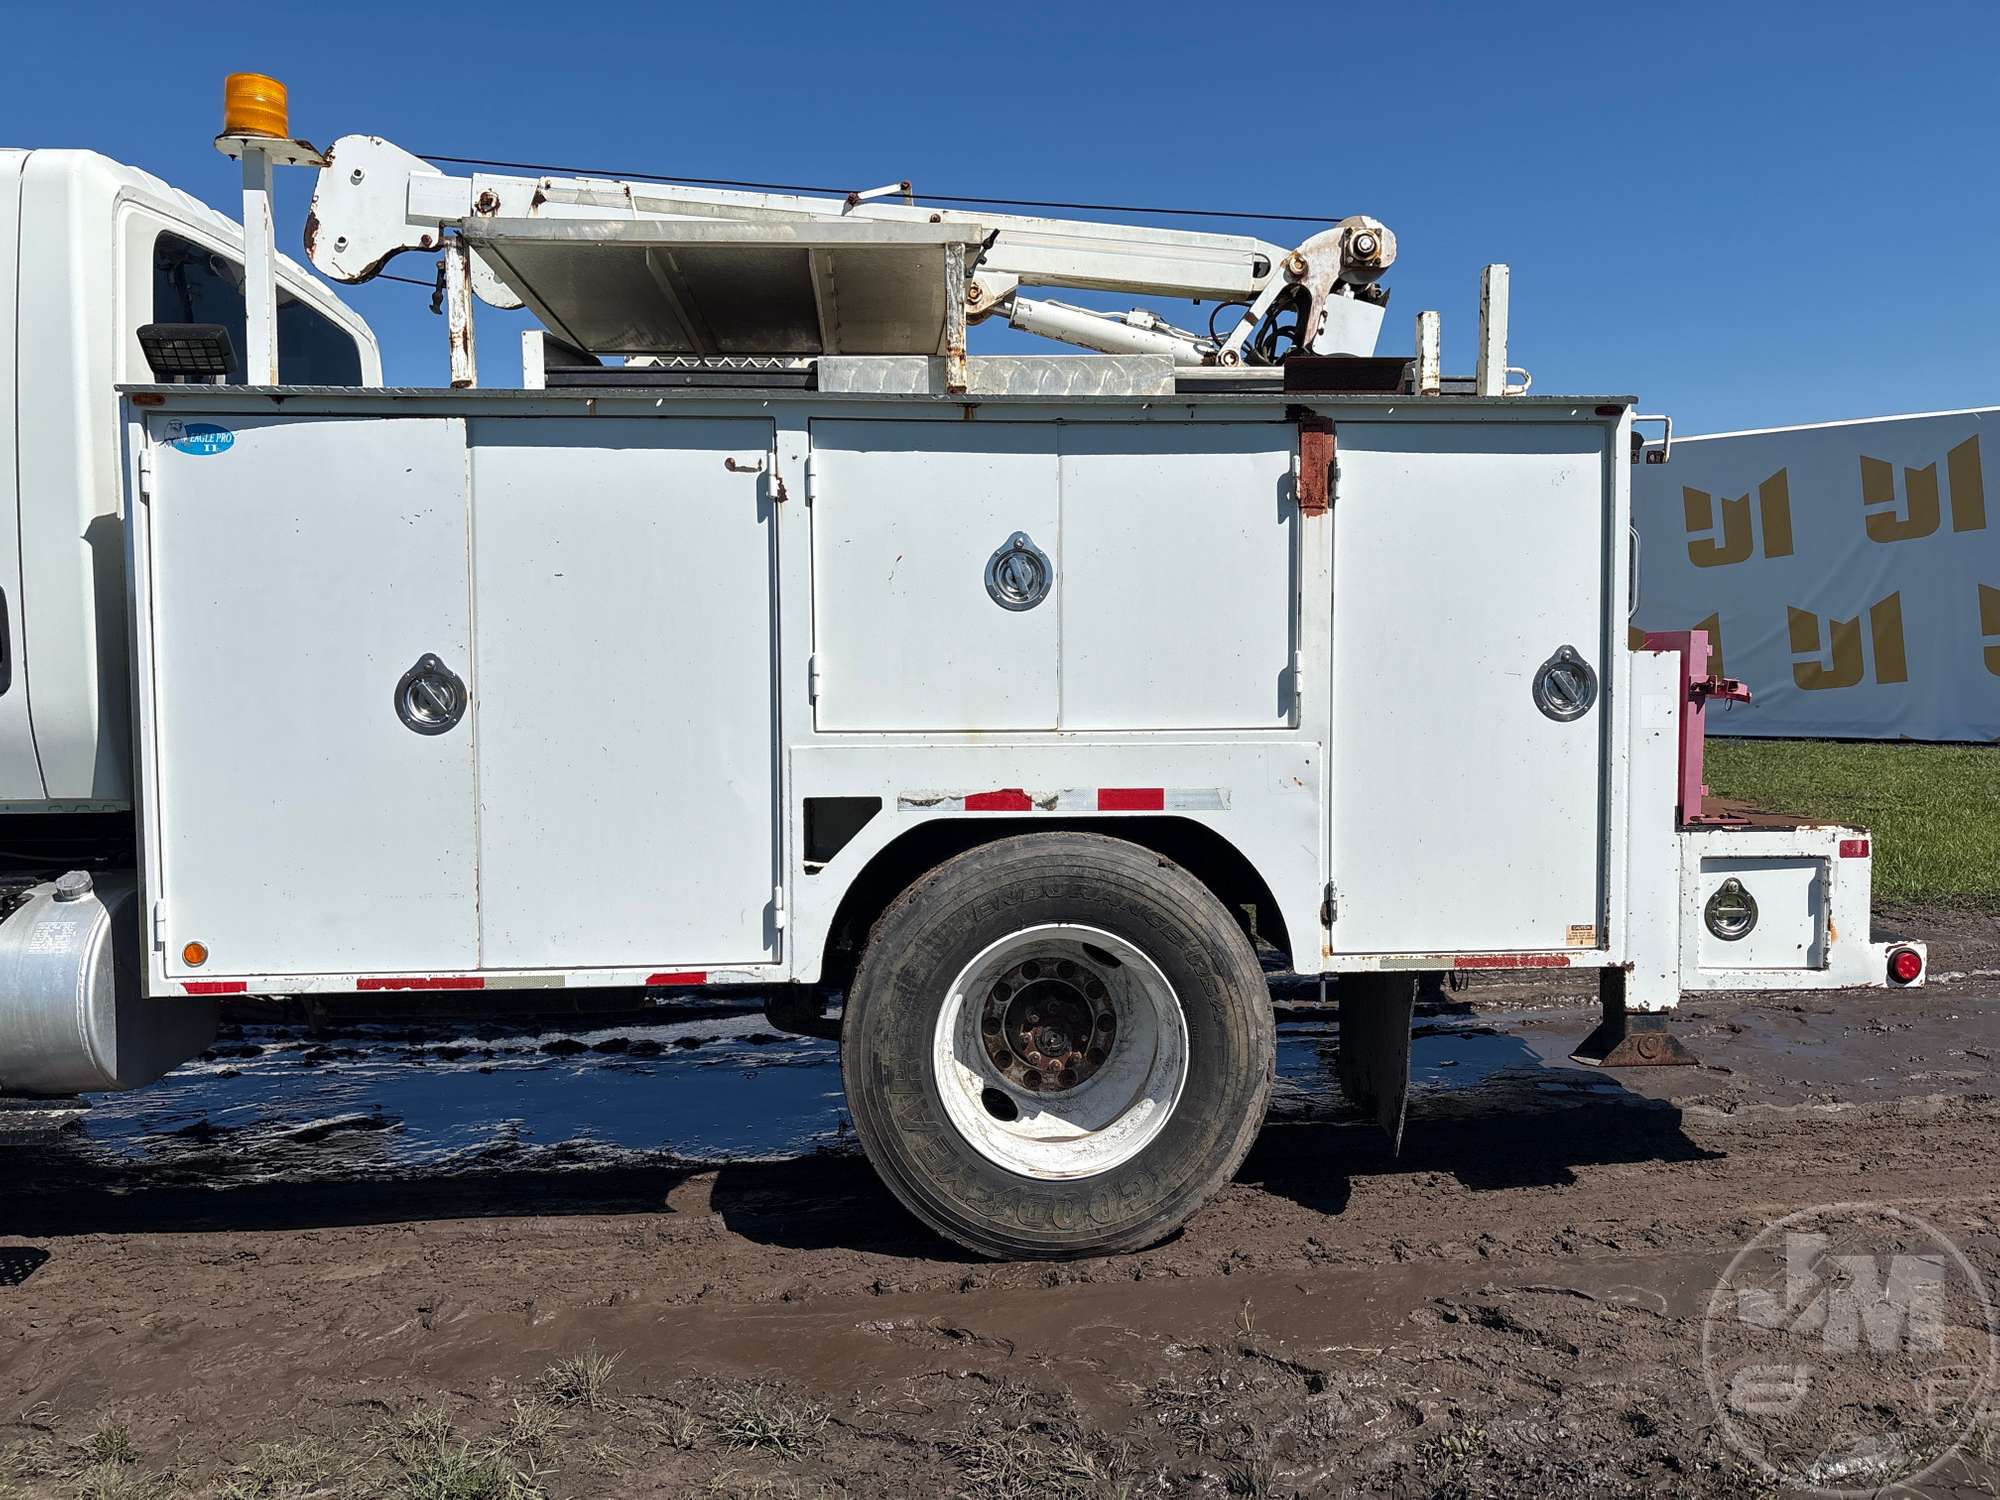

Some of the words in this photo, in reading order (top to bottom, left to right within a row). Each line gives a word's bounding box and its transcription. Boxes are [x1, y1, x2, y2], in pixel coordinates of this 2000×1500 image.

[190, 433, 214, 442] EAGLE
[216, 432, 232, 442] PRO
[973, 884, 1187, 948] ENDURANCE
[888, 1055, 1162, 1233] GOODYEAR
